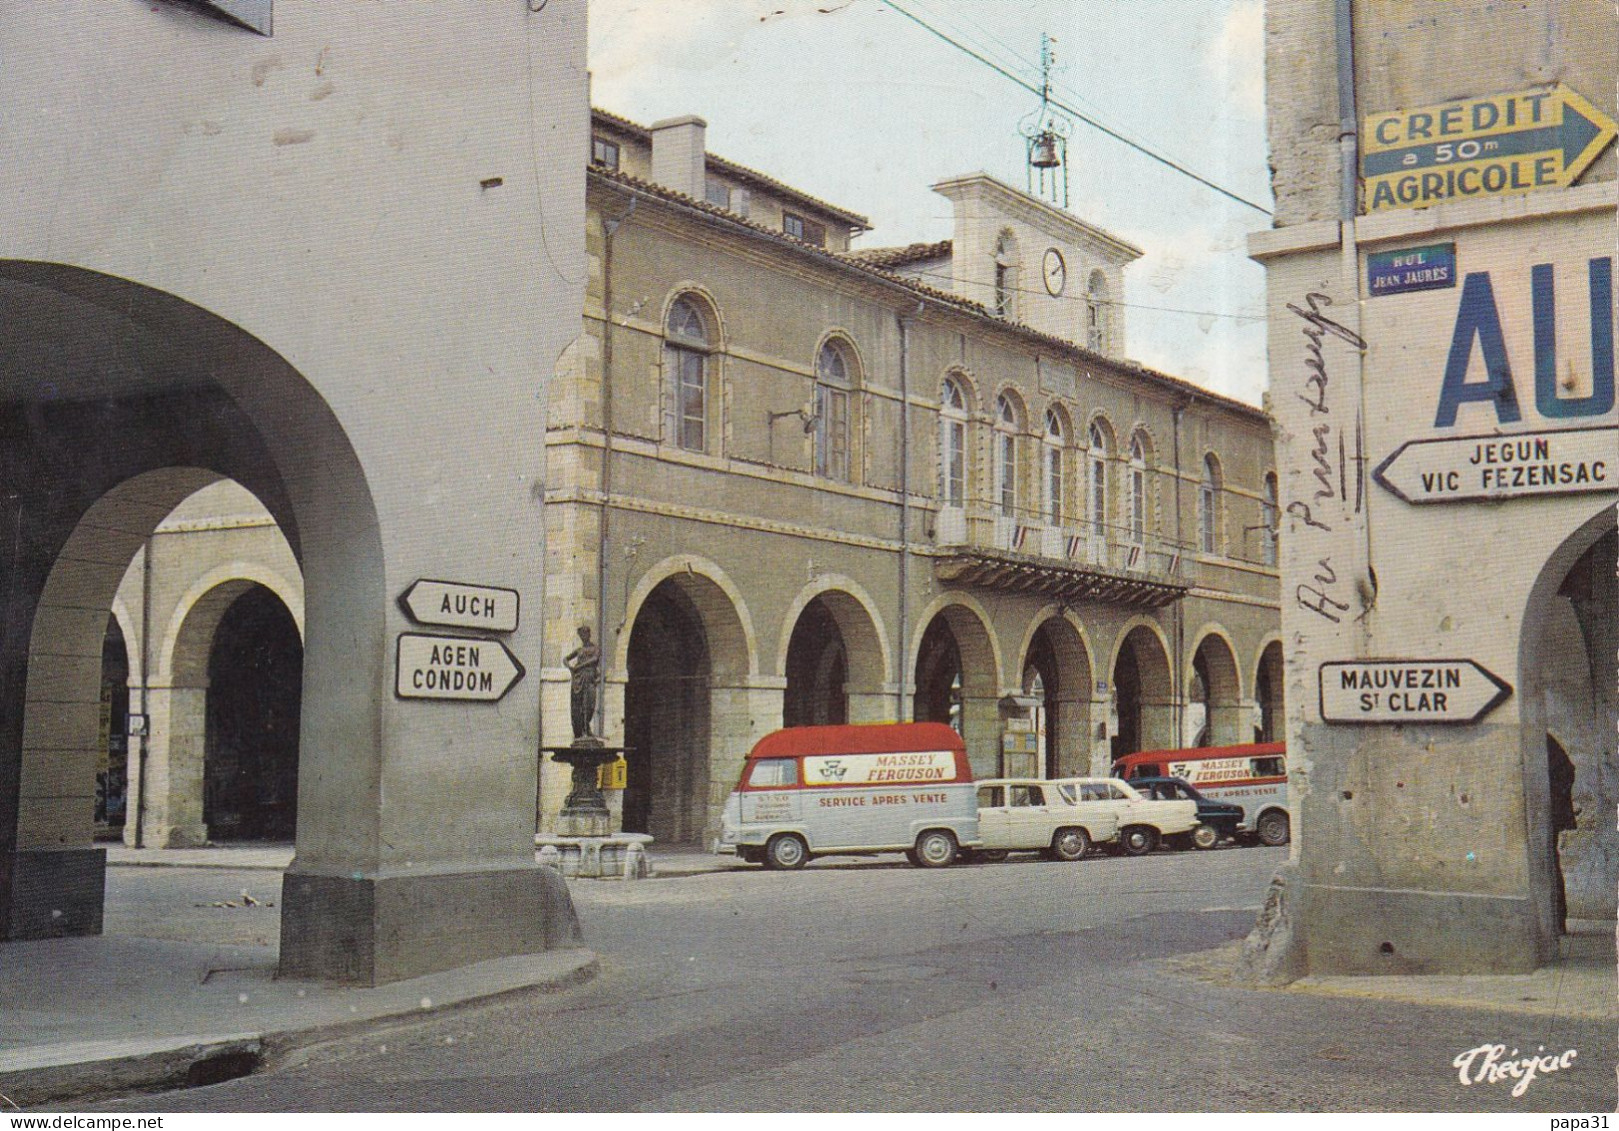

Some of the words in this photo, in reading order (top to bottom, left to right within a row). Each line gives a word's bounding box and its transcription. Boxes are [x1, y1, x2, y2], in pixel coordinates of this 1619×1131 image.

[1375, 93, 1551, 145] CREDIT
[1372, 156, 1558, 209] AGRICOLE
[1373, 275, 1400, 288] JEAN
[1434, 257, 1616, 428] AU
[1470, 440, 1549, 465] JEGUN
[1421, 472, 1460, 493] VIC
[1482, 461, 1606, 489] FEZENSAC
[1297, 557, 1350, 623] Au
[440, 593, 495, 618] AUCH
[430, 645, 479, 667] AGEN
[413, 668, 492, 692] CONDOM
[1341, 669, 1461, 690] MAUVEZIN
[1388, 693, 1448, 712] CLAR
[876, 754, 936, 767] MASSEY
[1201, 759, 1244, 770] MASSEY
[867, 767, 944, 781] FERGUSON
[1195, 769, 1250, 781] FERGUSON
[819, 797, 865, 808] SERVICE
[912, 793, 947, 804] VENTE
